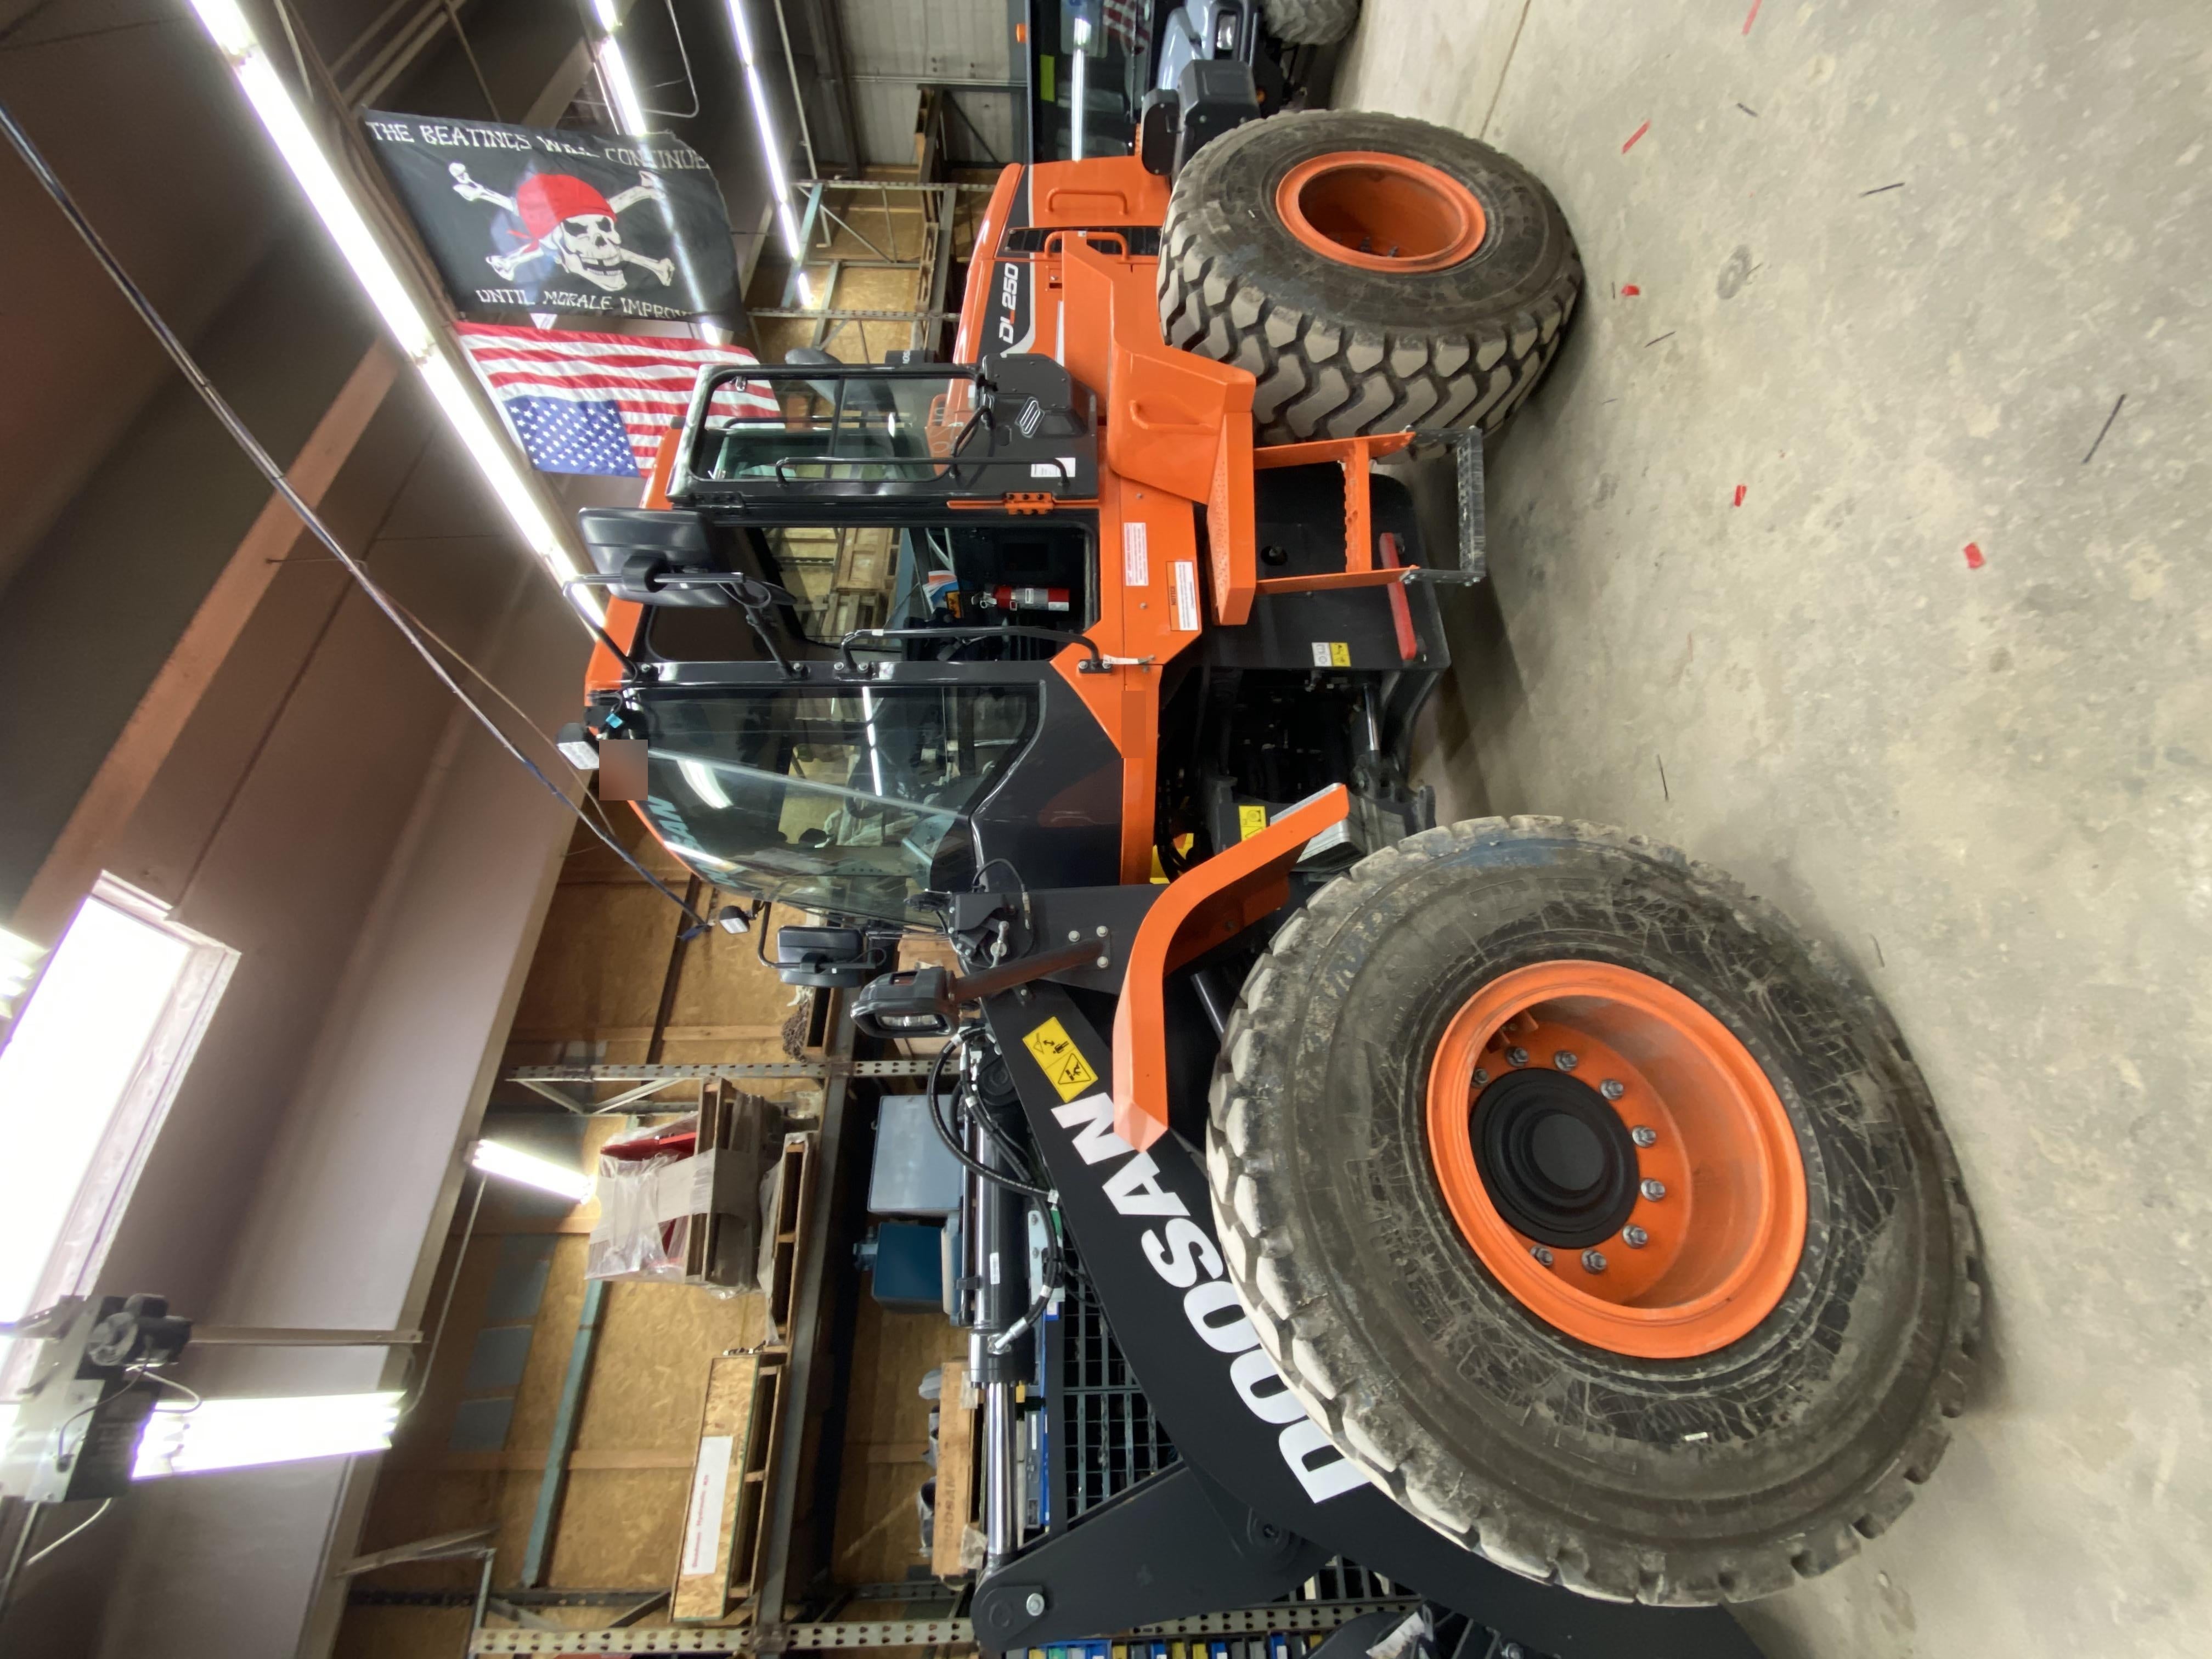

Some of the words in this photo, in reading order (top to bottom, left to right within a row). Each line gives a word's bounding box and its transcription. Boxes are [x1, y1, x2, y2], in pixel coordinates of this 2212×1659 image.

[365, 121, 415, 143] THE
[419, 125, 532, 151] BEATINGS
[476, 289, 535, 306] UNTIL
[543, 291, 613, 311] MORALE
[1051, 1092, 1372, 1504] DOOSAN
